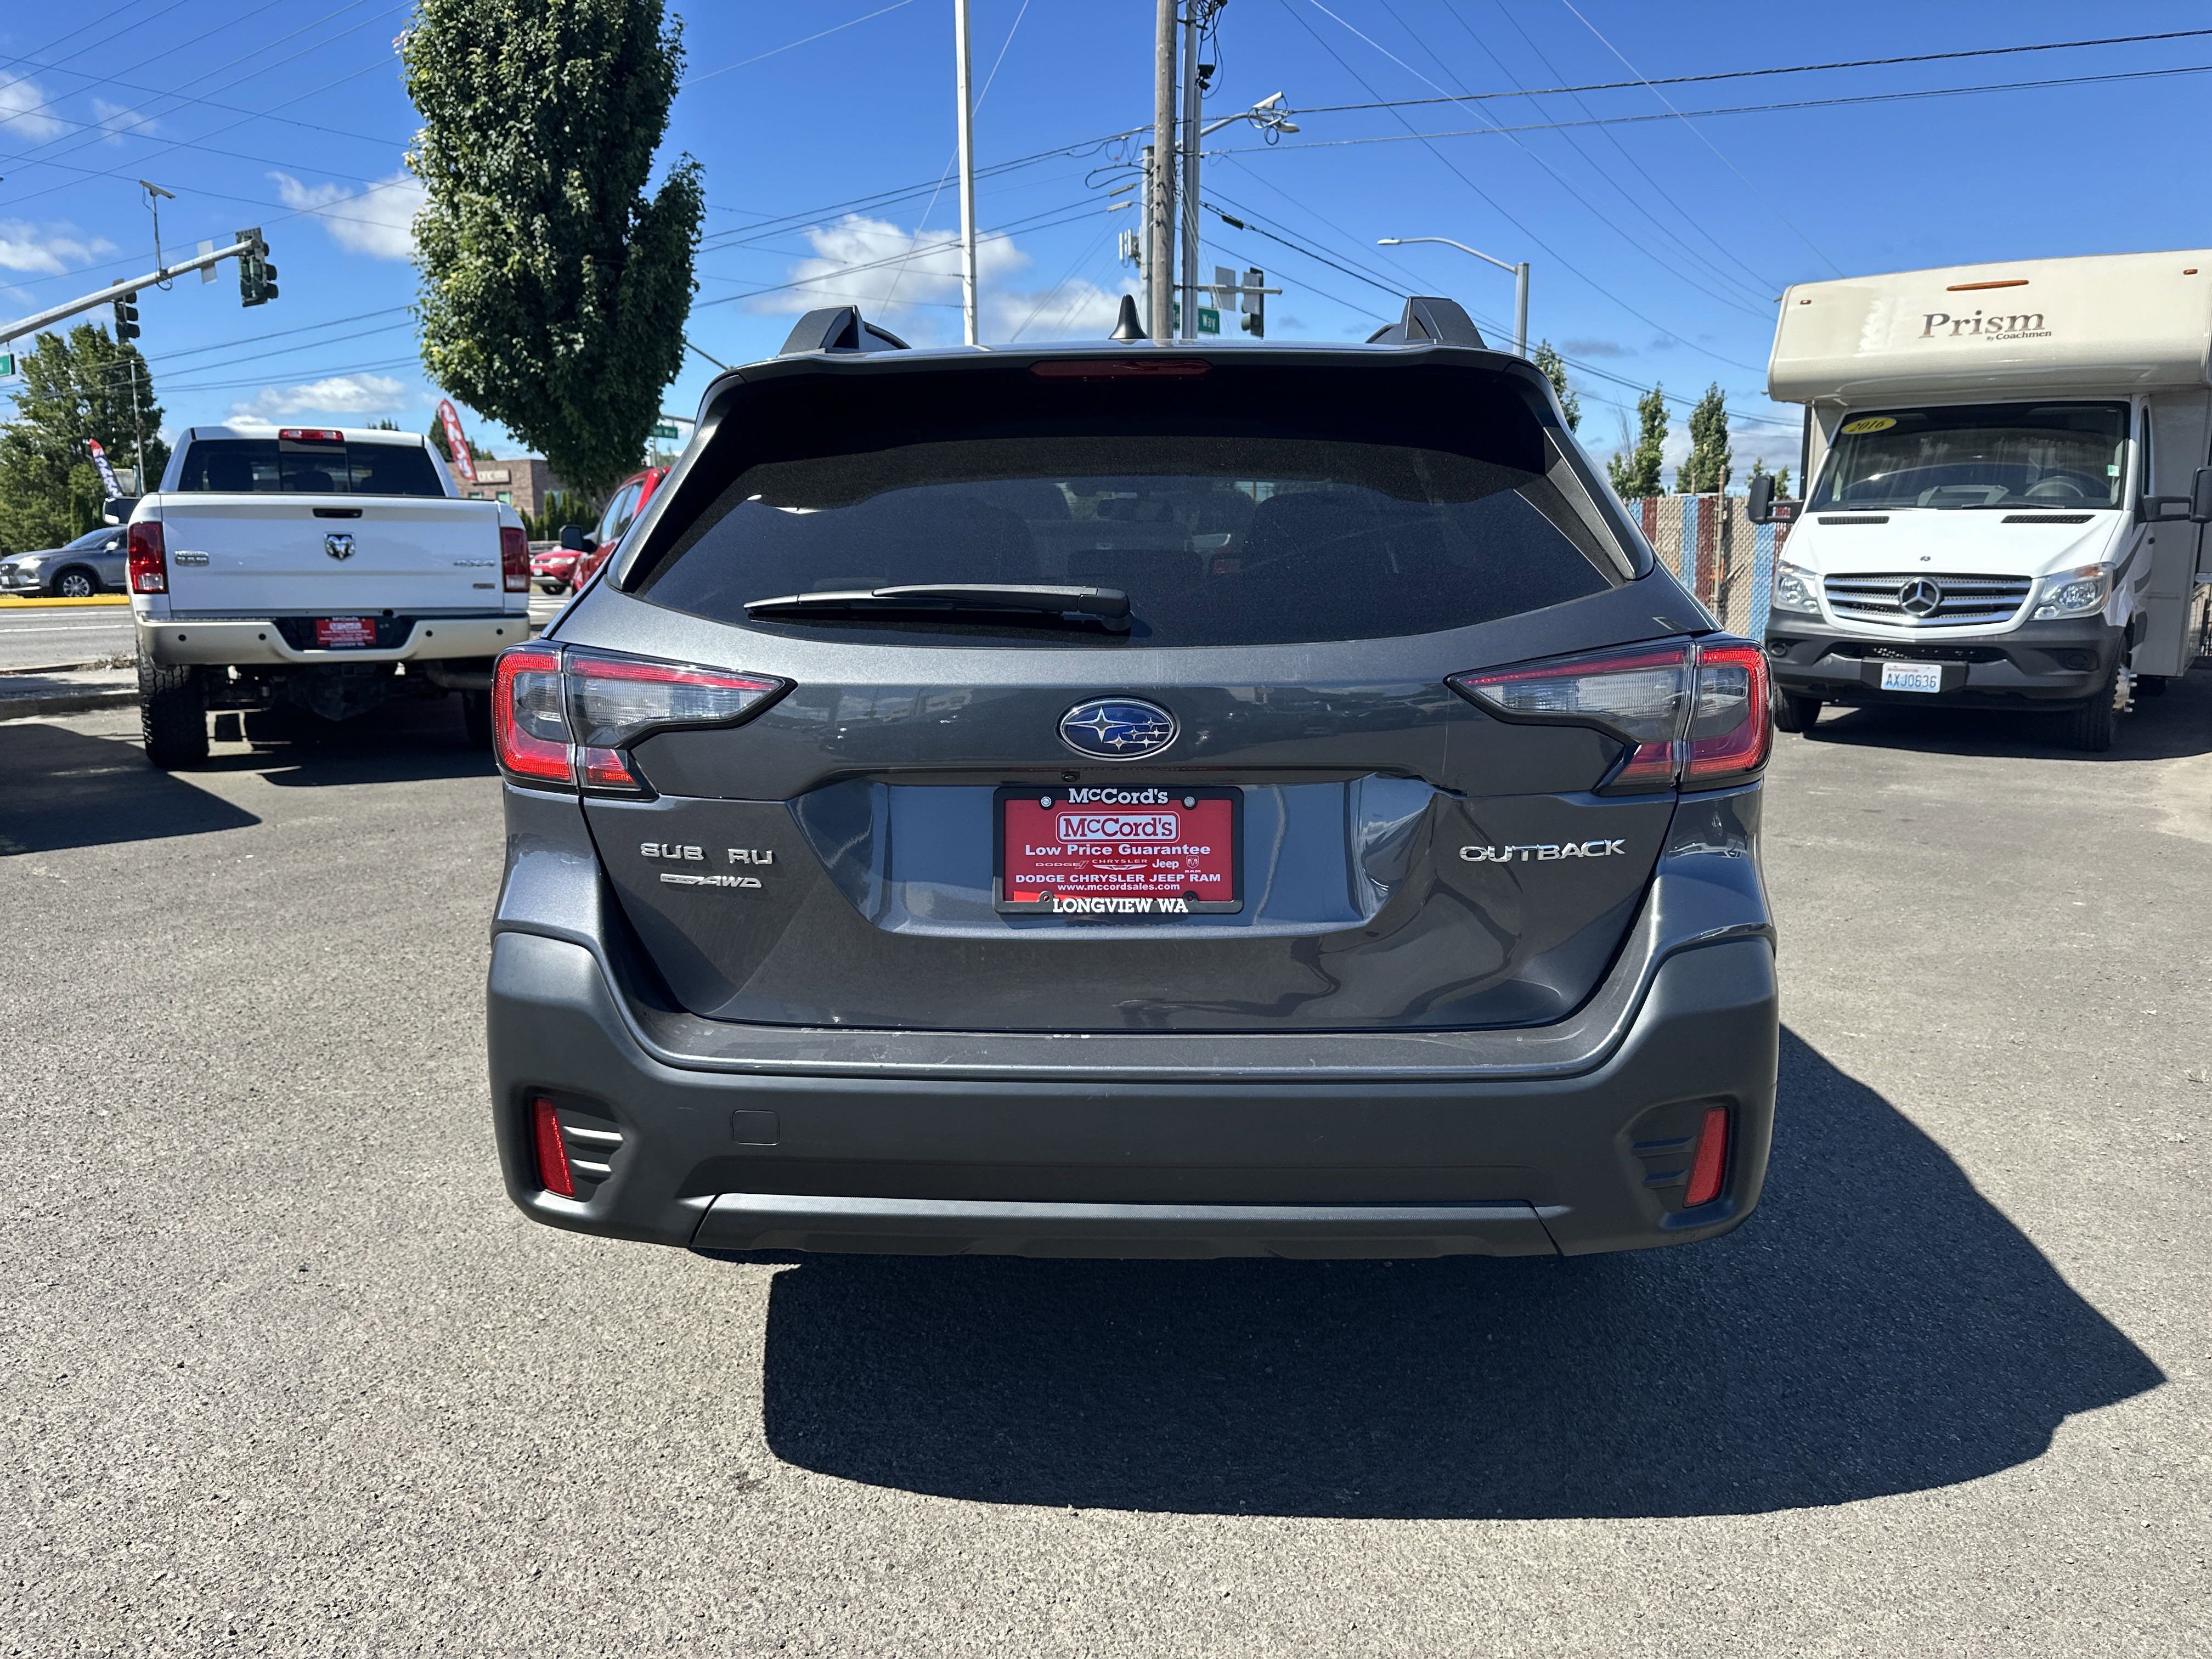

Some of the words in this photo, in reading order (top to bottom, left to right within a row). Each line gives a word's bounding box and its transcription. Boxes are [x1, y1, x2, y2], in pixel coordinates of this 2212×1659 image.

[1202, 314, 1216, 331] Way
[1918, 309, 2046, 338] Prism
[1996, 331, 2052, 340] Coachmen
[1849, 419, 1888, 432] 2016
[1886, 673, 1937, 688] AXJ0636
[1069, 788, 1169, 804] McCord's
[1063, 817, 1172, 837] McCord's
[1025, 844, 1062, 856] Low
[1067, 844, 1113, 855] Price
[1118, 844, 1211, 855] Guarantee
[1459, 839, 1626, 862] OUTBACK
[1152, 859, 1179, 870] Jeep
[698, 876, 762, 888] AWD
[1015, 874, 1065, 883] DODGE
[1069, 874, 1145, 883] CHRYSLER
[1149, 874, 1184, 882] JEEP
[1189, 873, 1221, 882] RAM
[1053, 897, 1153, 913] LONGVIEW
[1156, 897, 1189, 913] WA
